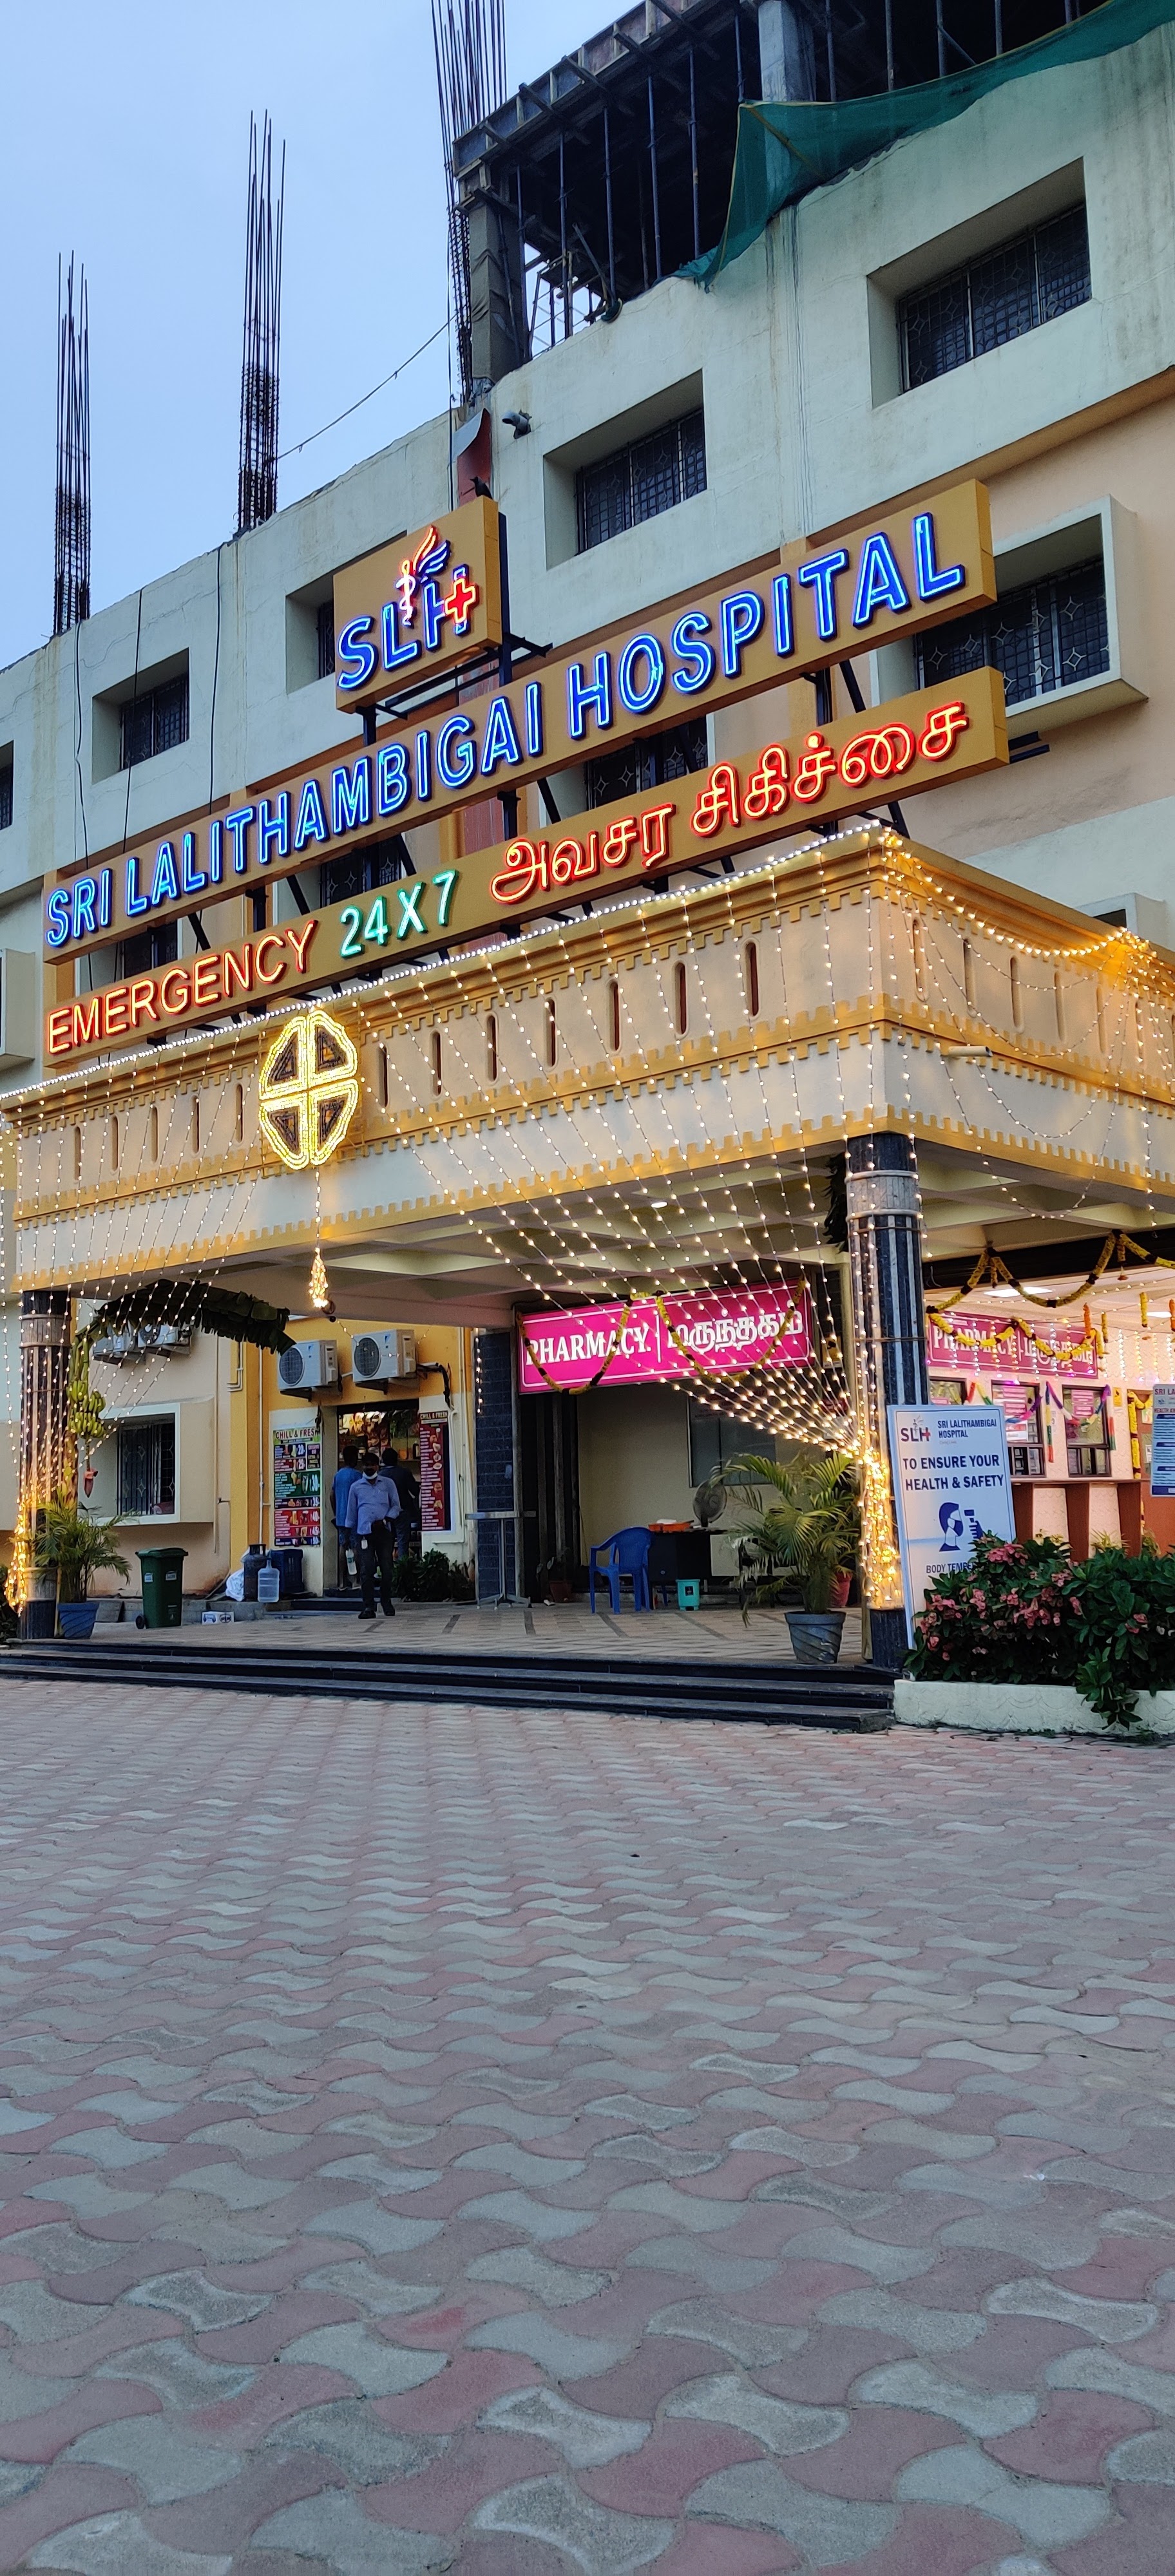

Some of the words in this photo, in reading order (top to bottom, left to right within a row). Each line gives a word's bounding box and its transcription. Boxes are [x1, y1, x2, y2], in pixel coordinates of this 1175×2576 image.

[46, 872, 113, 949] SRI
[126, 681, 542, 918] LALITHAMBIGAI
[568, 512, 966, 741] HOSPITAL
[490, 803, 675, 904] அவசர
[691, 701, 970, 837] சிகிச்சை
[48, 920, 319, 1056] EMERGENCY
[525, 1324, 649, 1366] PHARMACY
[937, 1419, 951, 1428] SRI
[950, 1419, 997, 1428] LALITHAMBIGAI
[276, 1430, 292, 1439] CHILL
[901, 1427, 930, 1442] SLH
[939, 1430, 968, 1439] HOSPITAL
[903, 1458, 917, 1470] TO
[921, 1456, 967, 1469] ENSURE
[969, 1455, 1000, 1468] YOUR
[905, 1477, 948, 1491] HEALTH
[952, 1477, 960, 1489] &
[963, 1474, 1004, 1488] SAFETY
[926, 1564, 946, 1573] BODY
